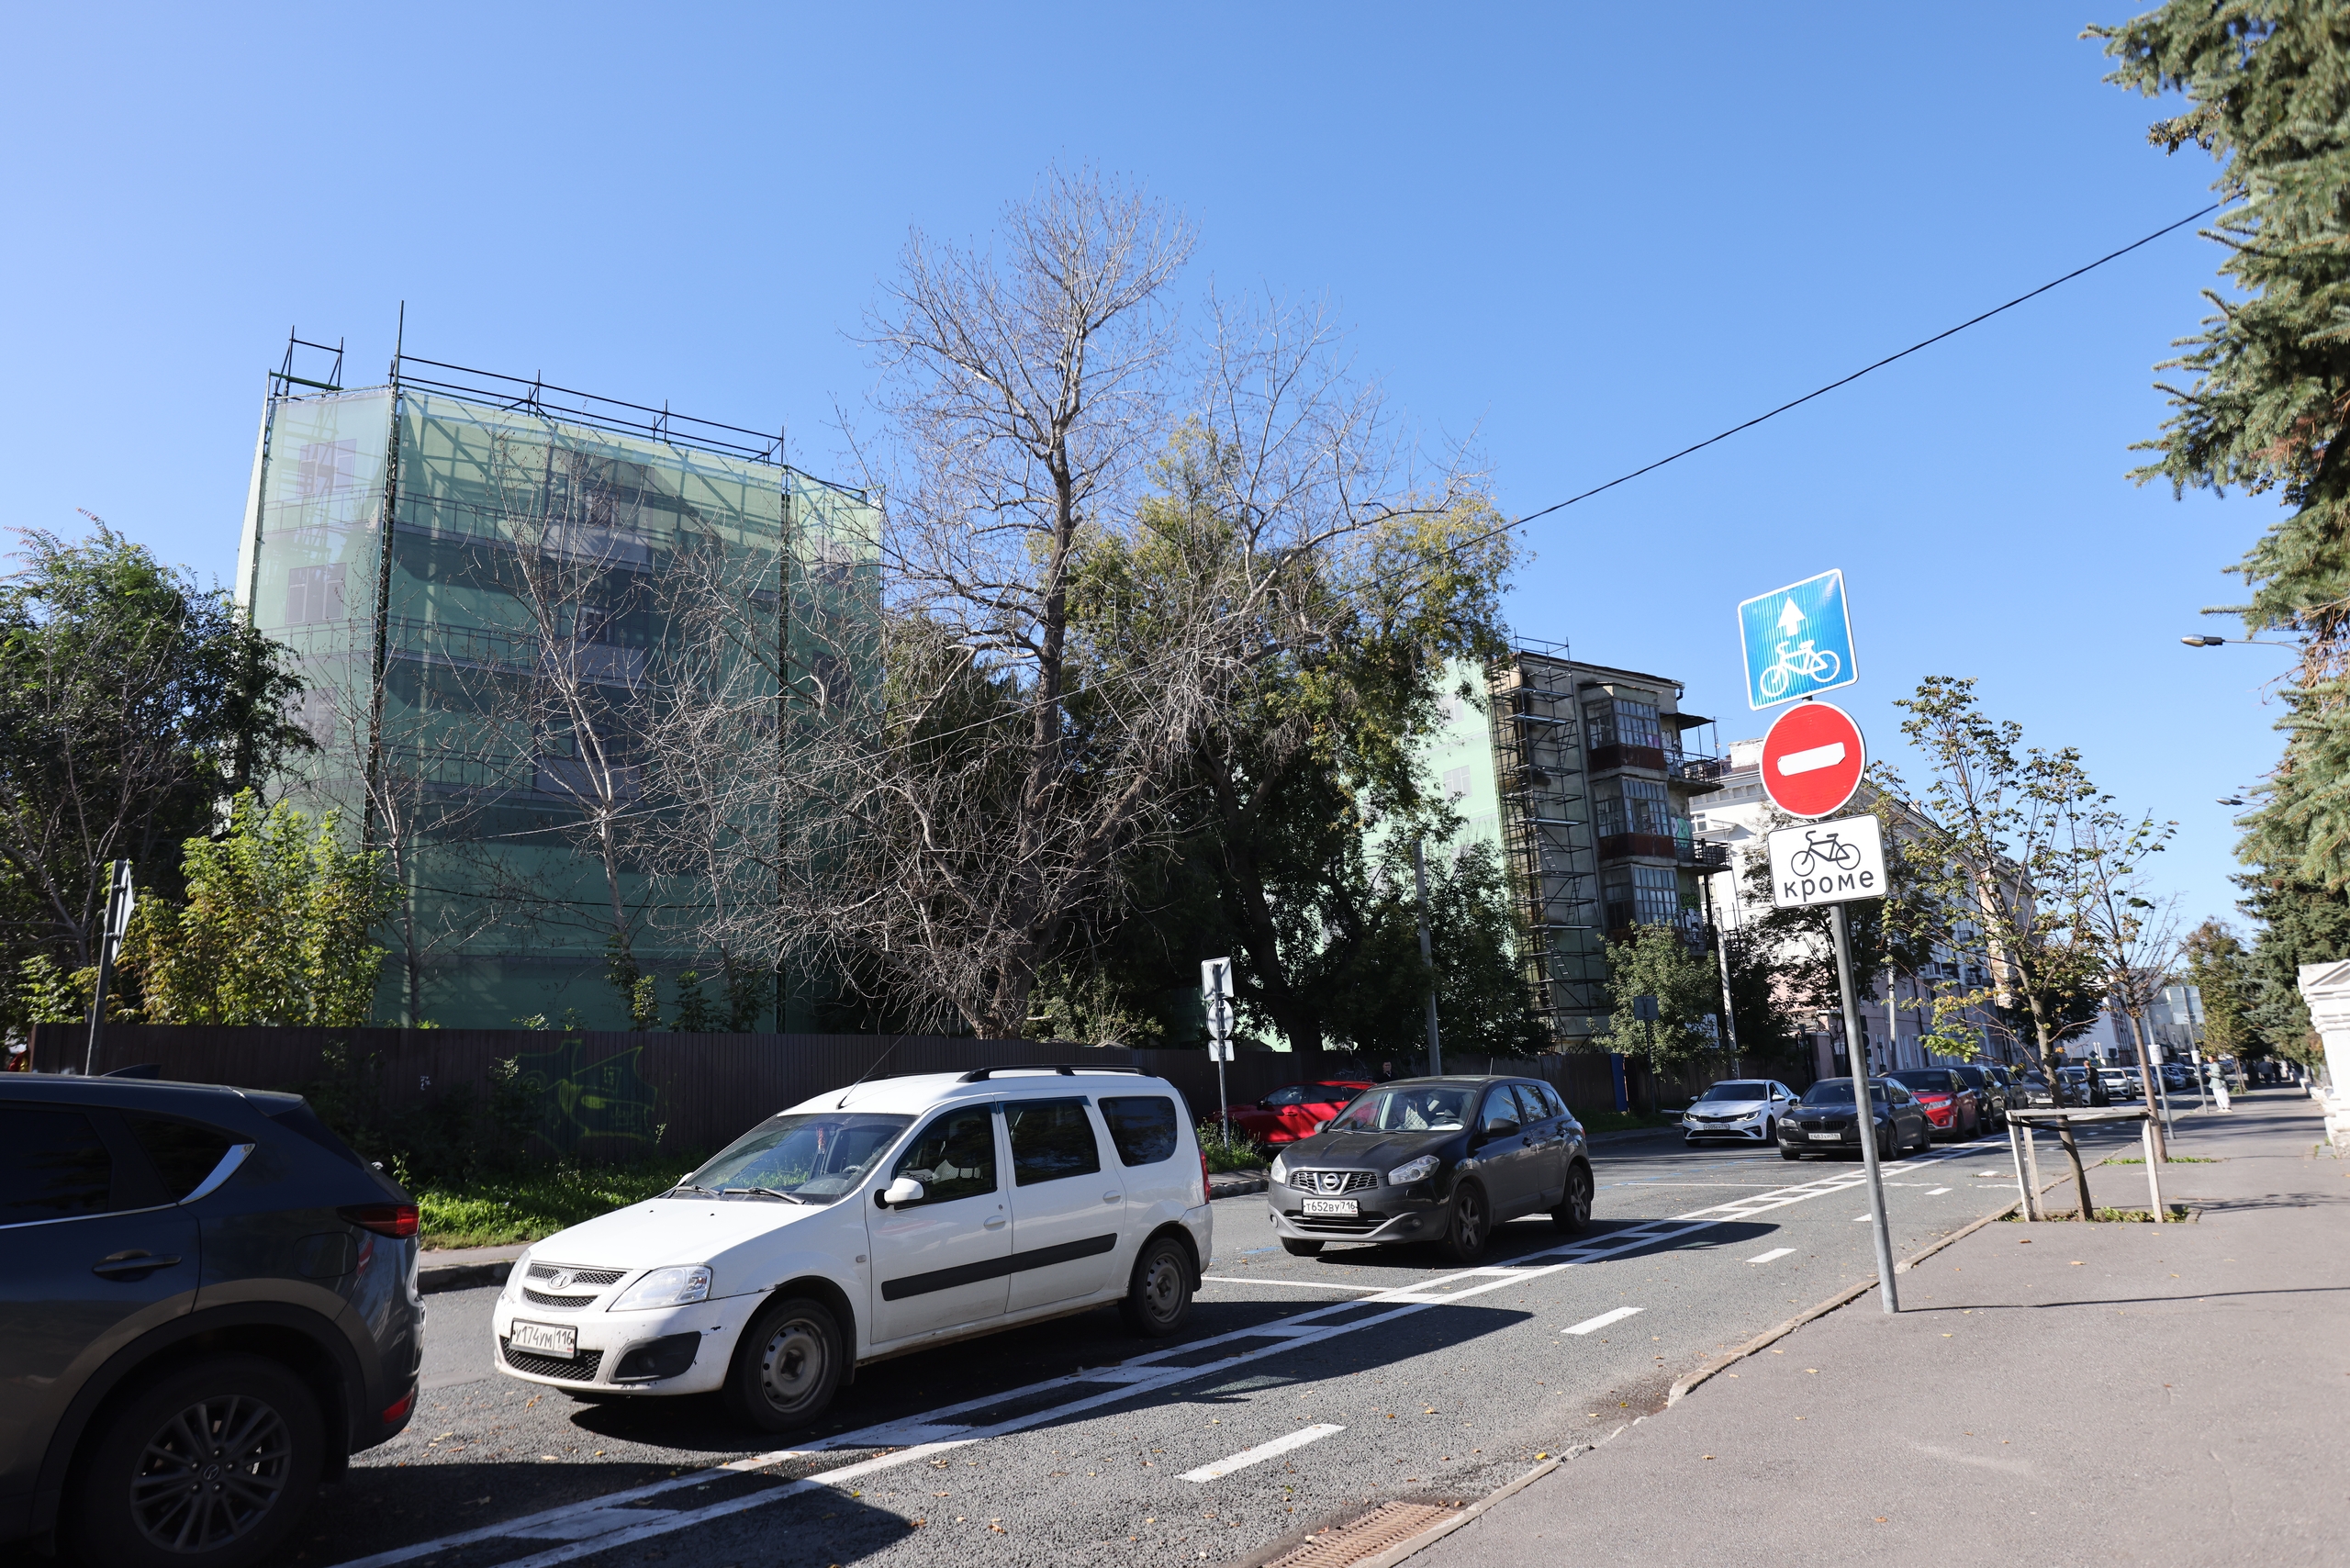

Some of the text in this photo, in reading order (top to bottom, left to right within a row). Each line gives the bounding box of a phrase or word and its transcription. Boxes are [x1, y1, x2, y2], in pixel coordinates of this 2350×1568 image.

[1784, 870, 1874, 902] кроме
[1306, 1201, 1355, 1212] Т652ВУ 716
[516, 1326, 572, 1349] У174УМ 116
